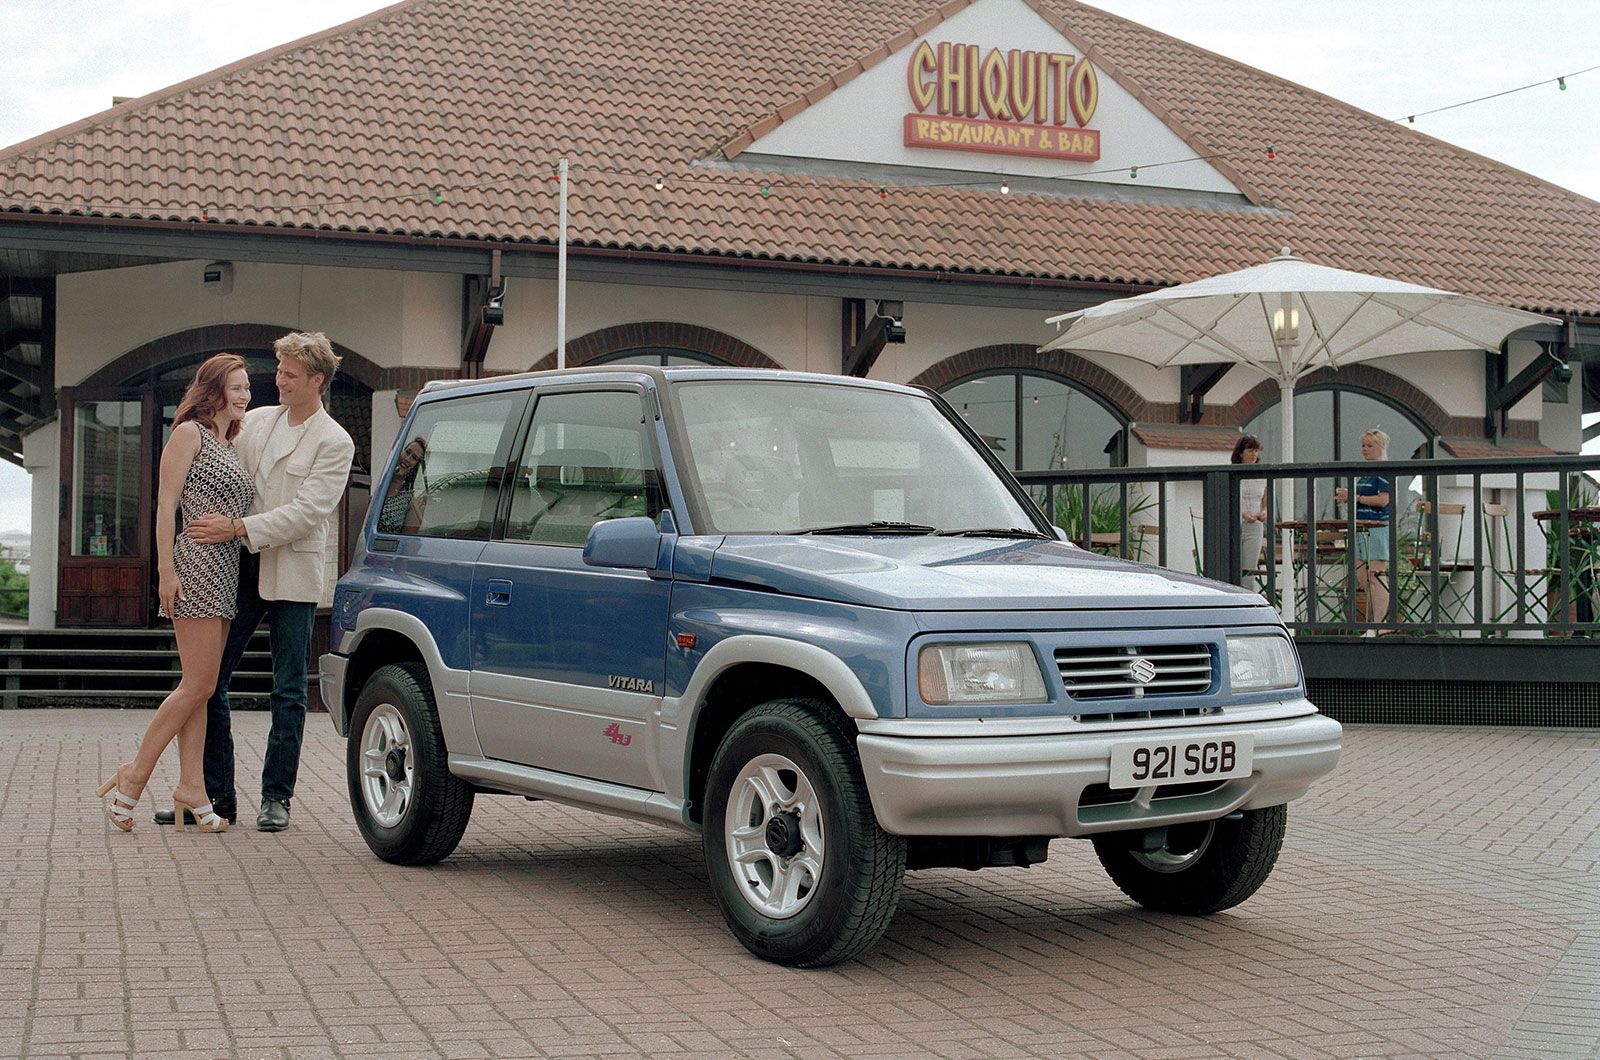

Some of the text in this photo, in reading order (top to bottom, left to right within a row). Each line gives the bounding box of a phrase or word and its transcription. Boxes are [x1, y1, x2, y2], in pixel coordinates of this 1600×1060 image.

[907, 39, 1099, 128] CHIQUITO
[916, 118, 1095, 154] RESTAURANT & BAR
[608, 675, 654, 692] VITARA
[1132, 740, 1236, 780] 921 SGB
